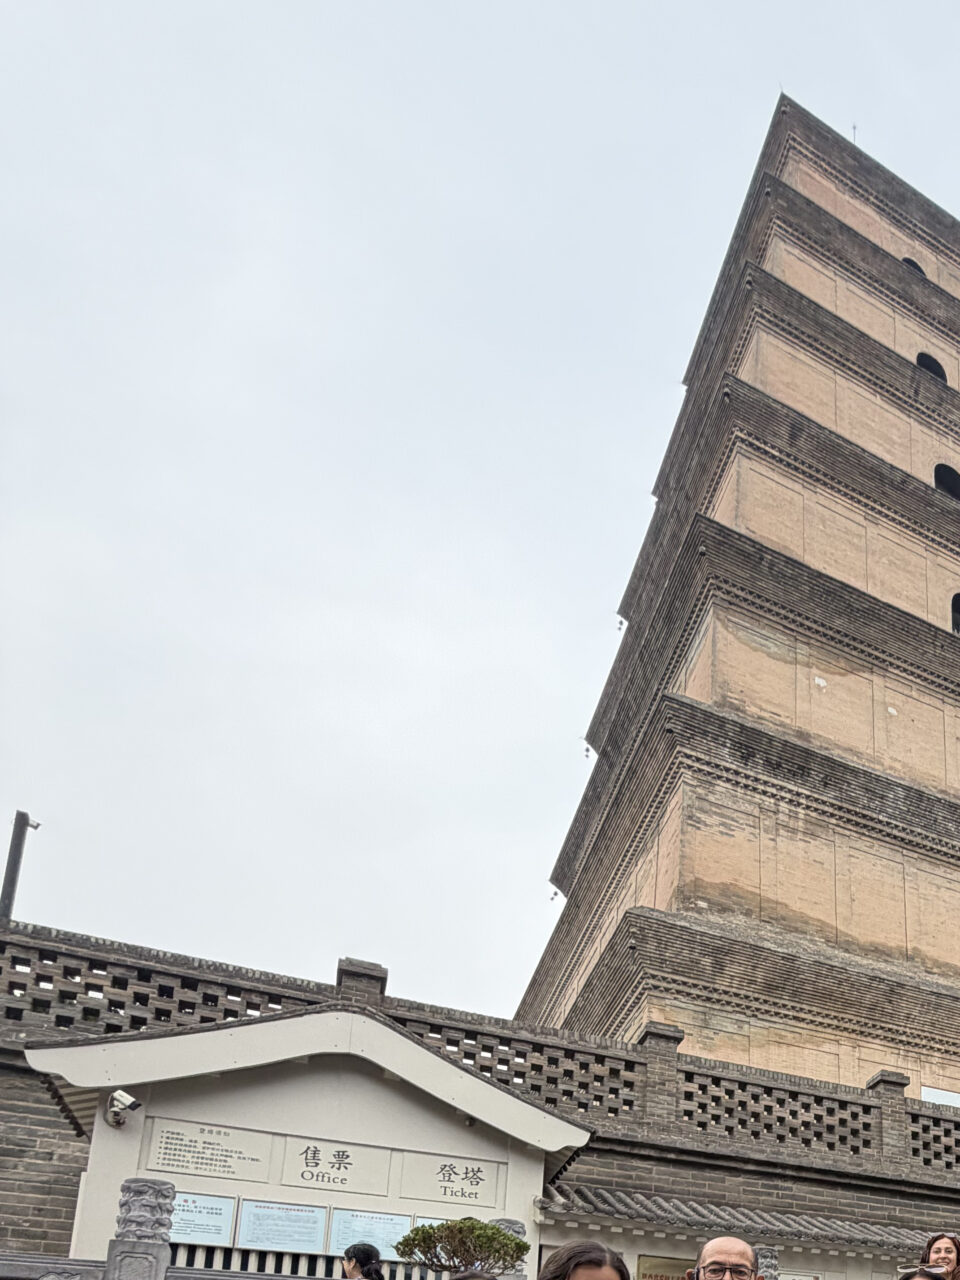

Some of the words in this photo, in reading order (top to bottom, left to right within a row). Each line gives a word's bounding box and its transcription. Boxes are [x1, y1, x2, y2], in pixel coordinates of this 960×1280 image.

[299, 1145, 353, 1170] 售票
[300, 1170, 348, 1185] Office
[436, 1163, 486, 1187] 登塔
[440, 1185, 479, 1199] Ticket
